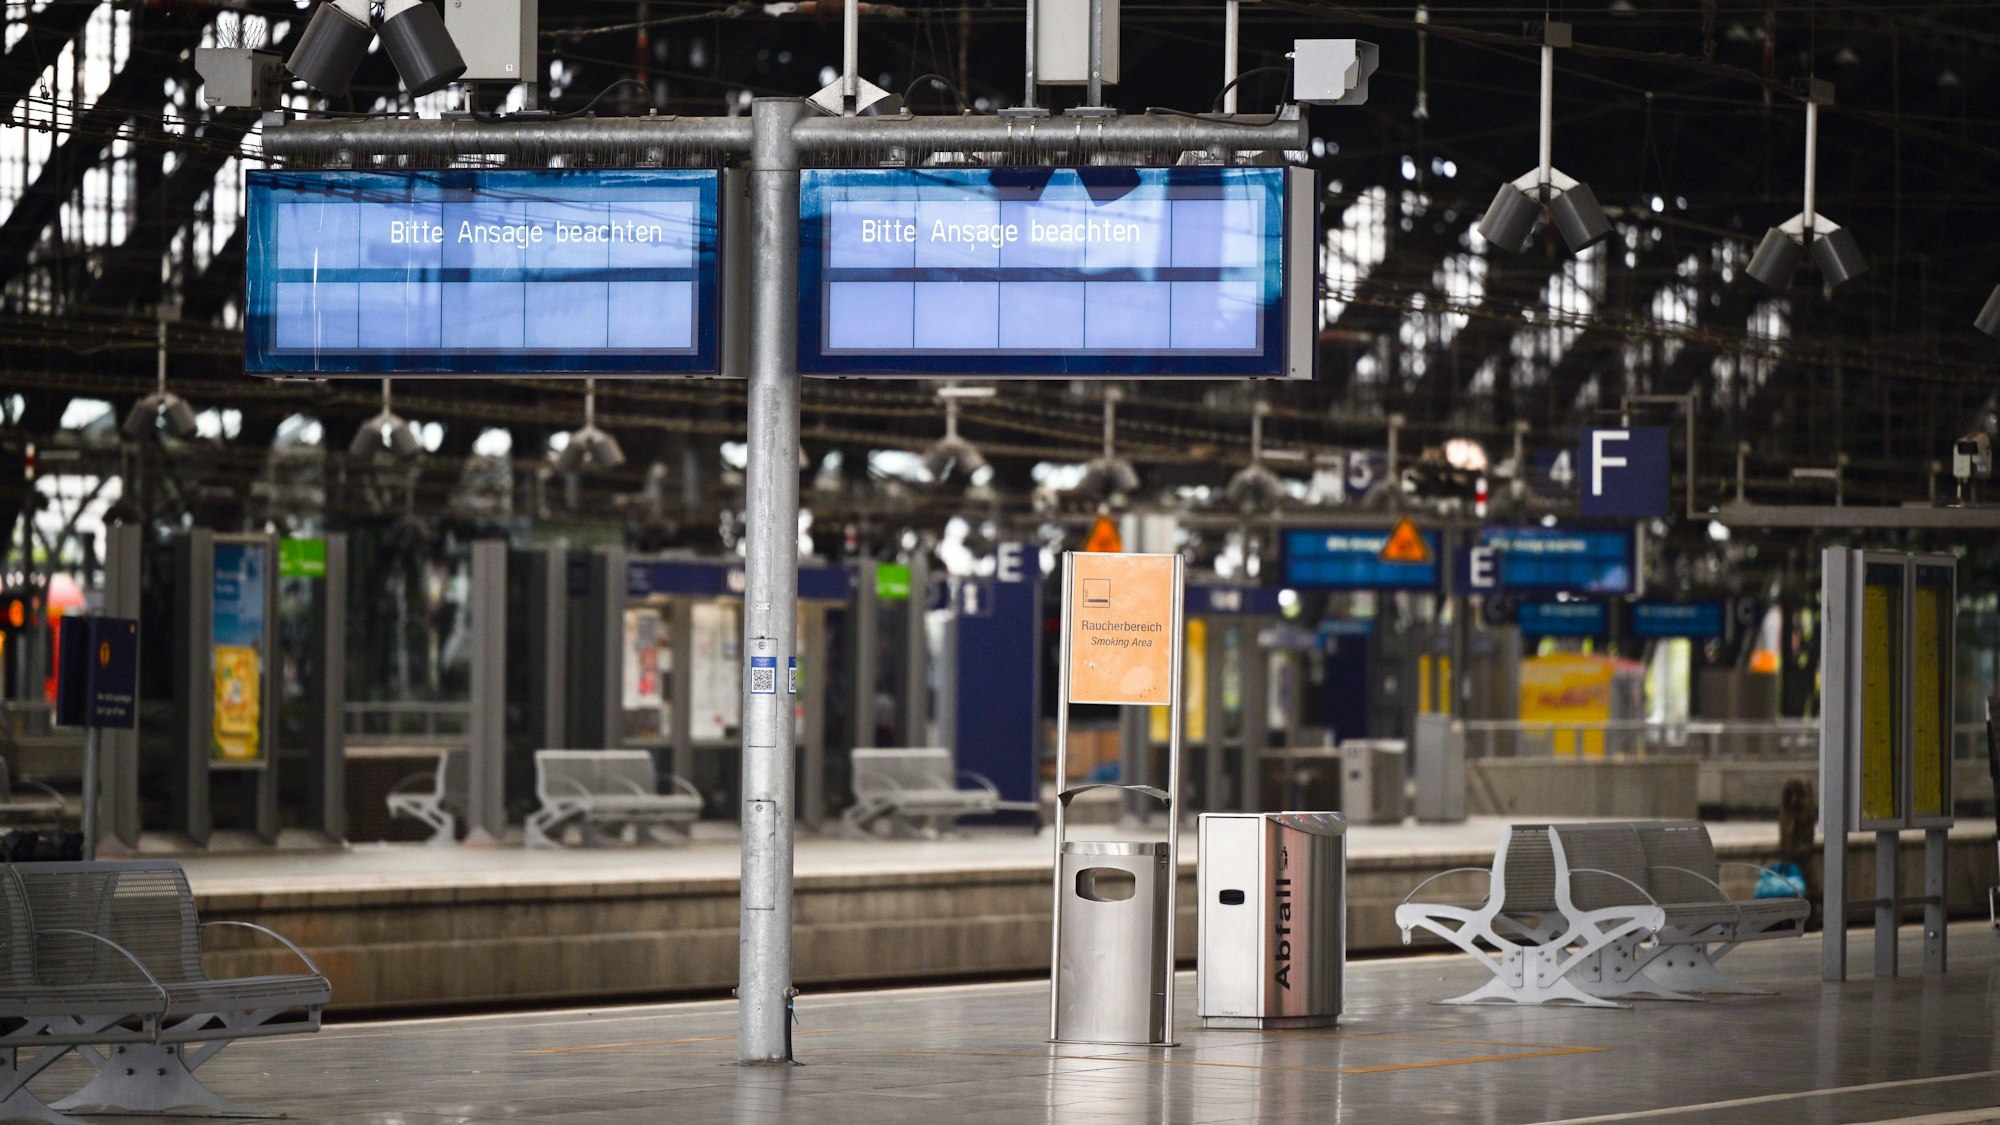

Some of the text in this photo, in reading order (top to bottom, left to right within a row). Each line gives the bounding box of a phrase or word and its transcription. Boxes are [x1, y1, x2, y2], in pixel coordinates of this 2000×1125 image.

[391, 219, 662, 249] Bitte Ansage beachten
[862, 218, 1140, 249] Bitte Ansage beachten
[1349, 451, 1373, 489] 5
[1549, 449, 1574, 489] 4
[1592, 430, 1630, 496] F
[997, 541, 1023, 582] E
[1470, 546, 1495, 587] E
[1081, 620, 1162, 632] Raucherbereich
[1090, 636, 1152, 648] Smoking Area
[1275, 879, 1291, 990] Abfall
